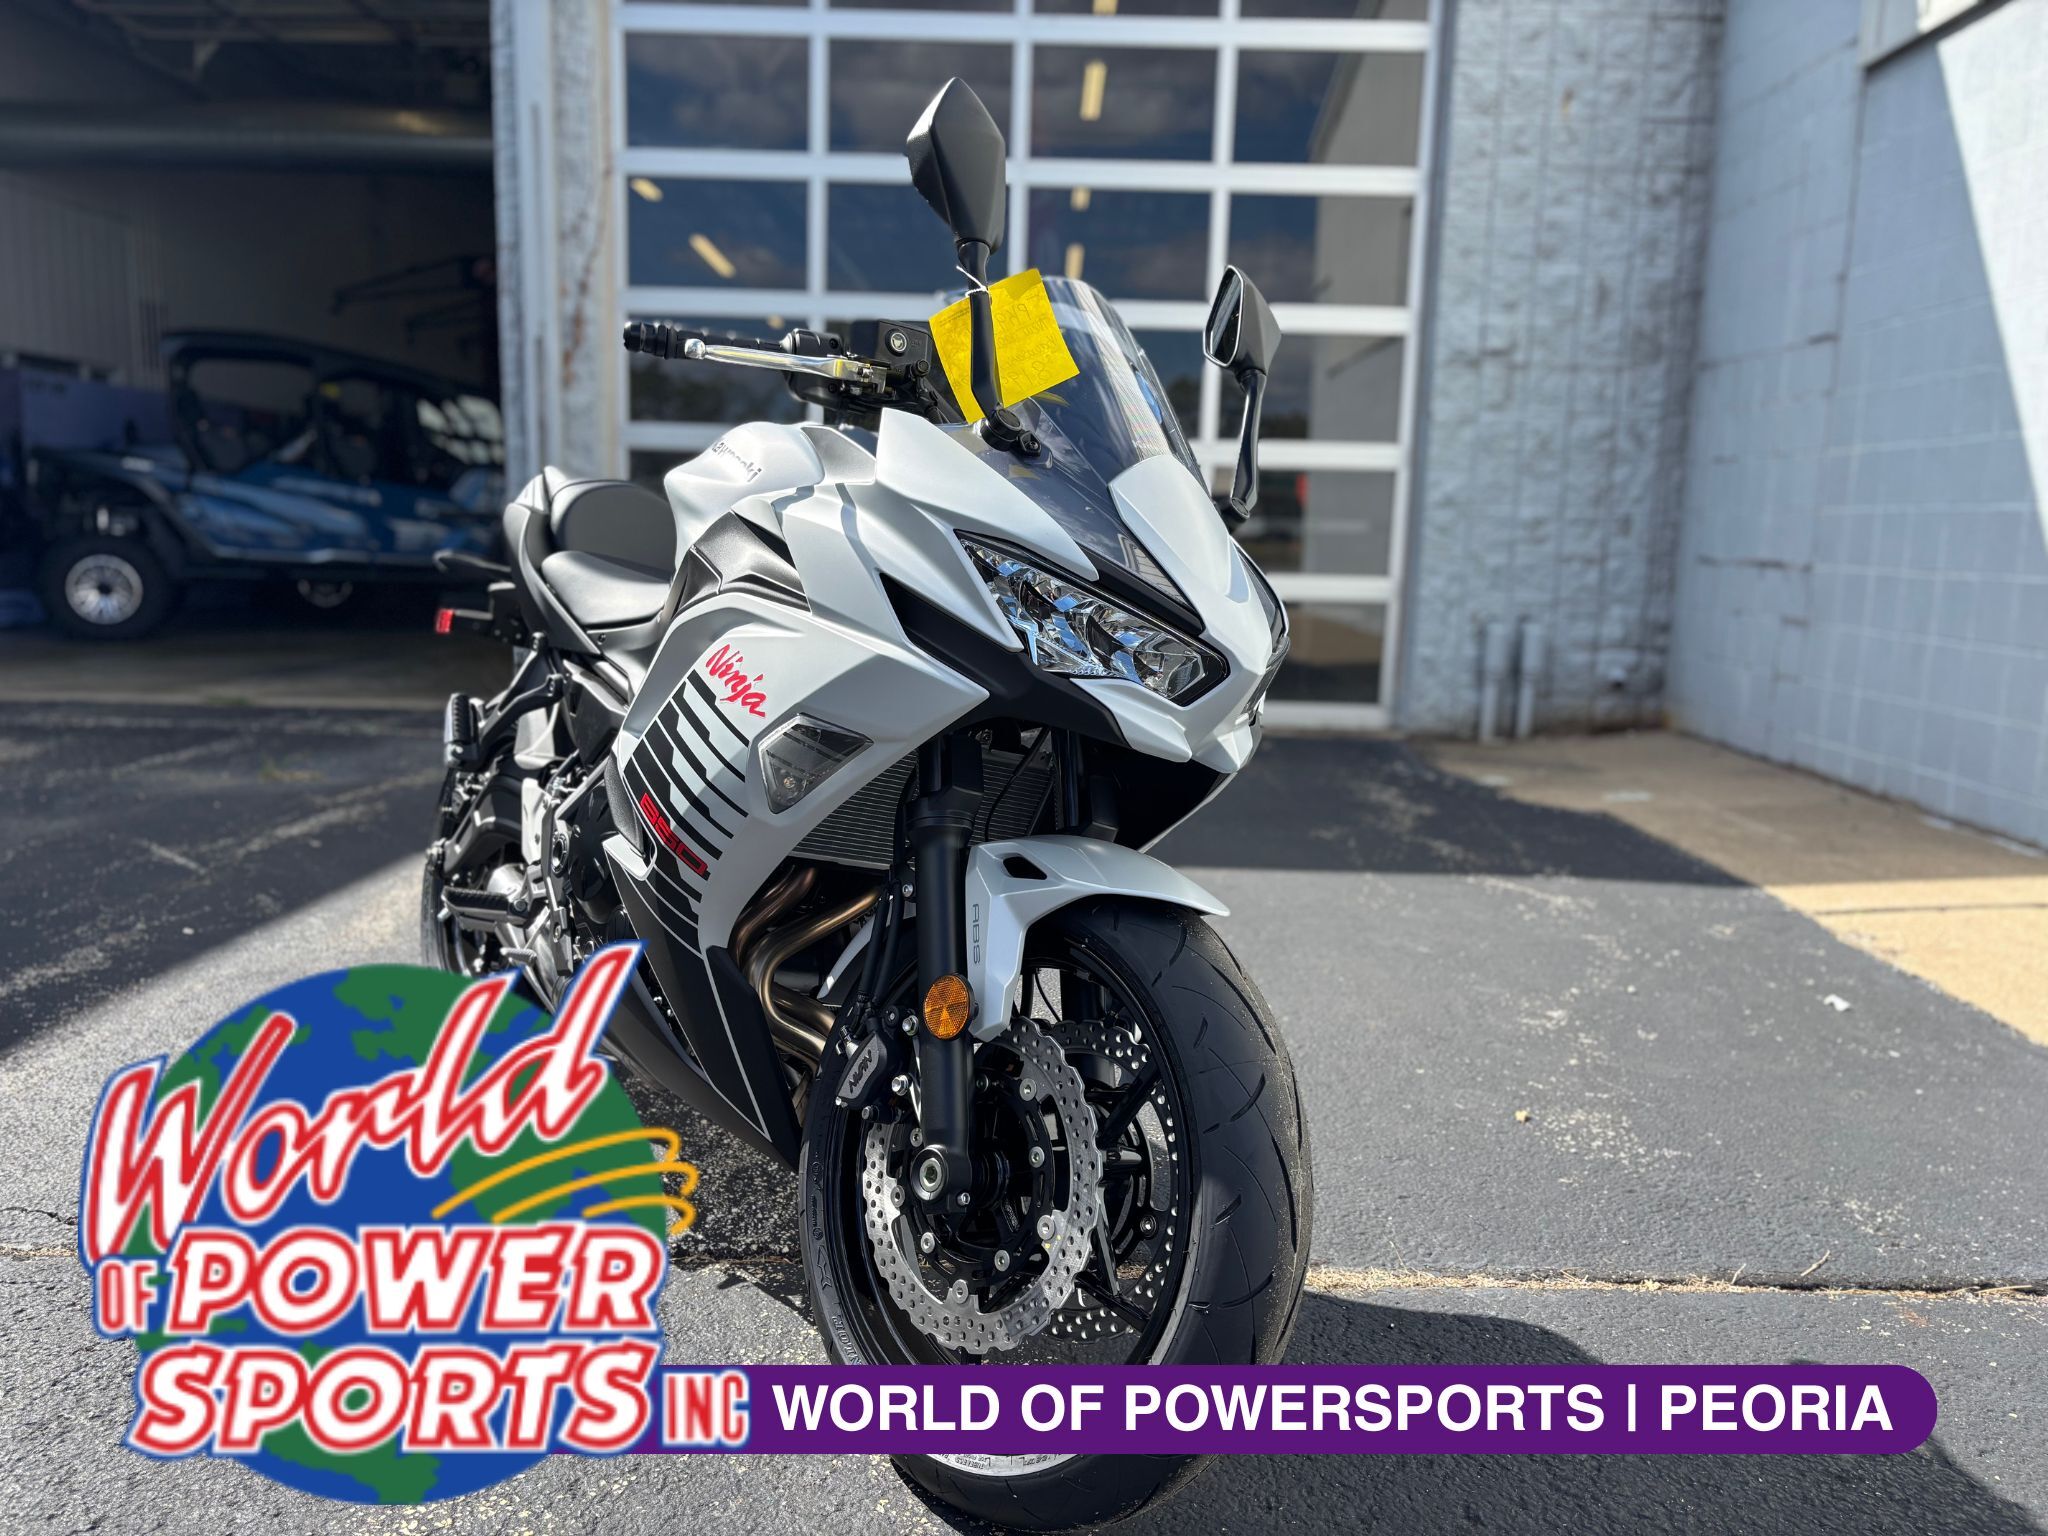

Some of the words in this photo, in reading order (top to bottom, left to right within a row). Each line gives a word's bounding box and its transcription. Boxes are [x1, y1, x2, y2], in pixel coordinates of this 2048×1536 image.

[705, 643, 767, 718] Ninja
[640, 792, 709, 878] 650
[972, 903, 981, 965] ABS
